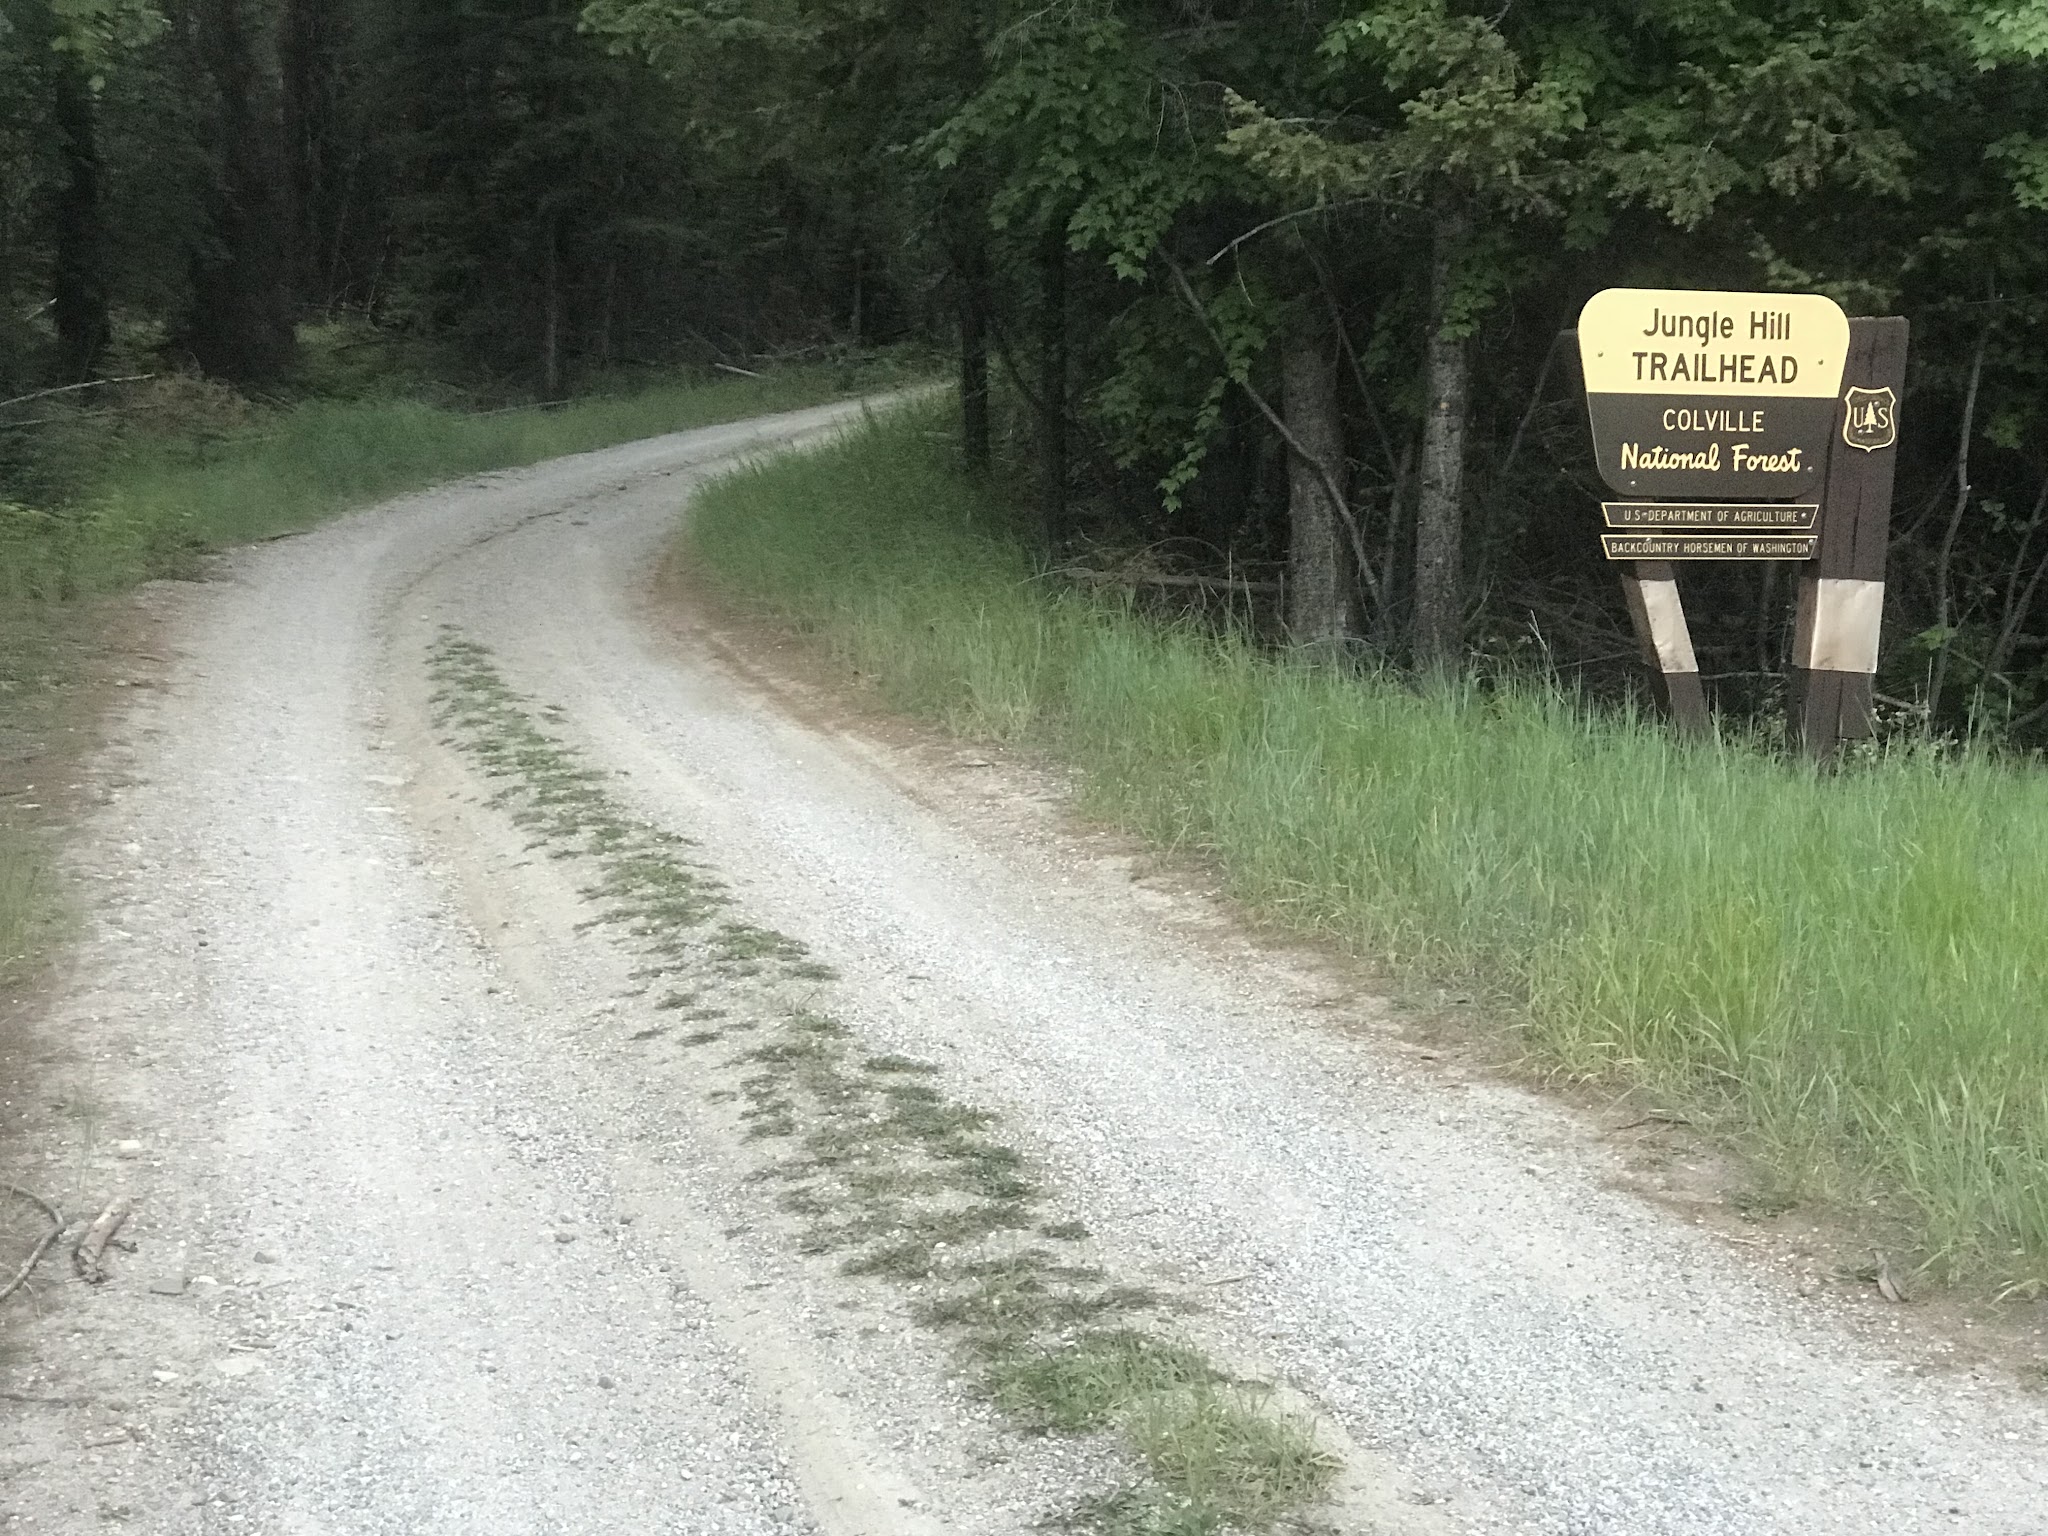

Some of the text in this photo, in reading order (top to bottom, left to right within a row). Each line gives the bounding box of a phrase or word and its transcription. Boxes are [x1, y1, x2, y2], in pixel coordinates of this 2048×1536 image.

[1643, 308, 1791, 347] Jungle Hill
[1632, 352, 1798, 384] TRAILHEAD
[1663, 409, 1765, 432] COLVILLE
[1621, 442, 1803, 472] National Forest
[1648, 509, 1713, 522] DEPARTMENT
[1717, 510, 1730, 522] OF
[1733, 510, 1799, 523] AGRICULTURE
[1611, 542, 1809, 554] BACKCOUNTRY HORSEMEN OF WASHINGTON
